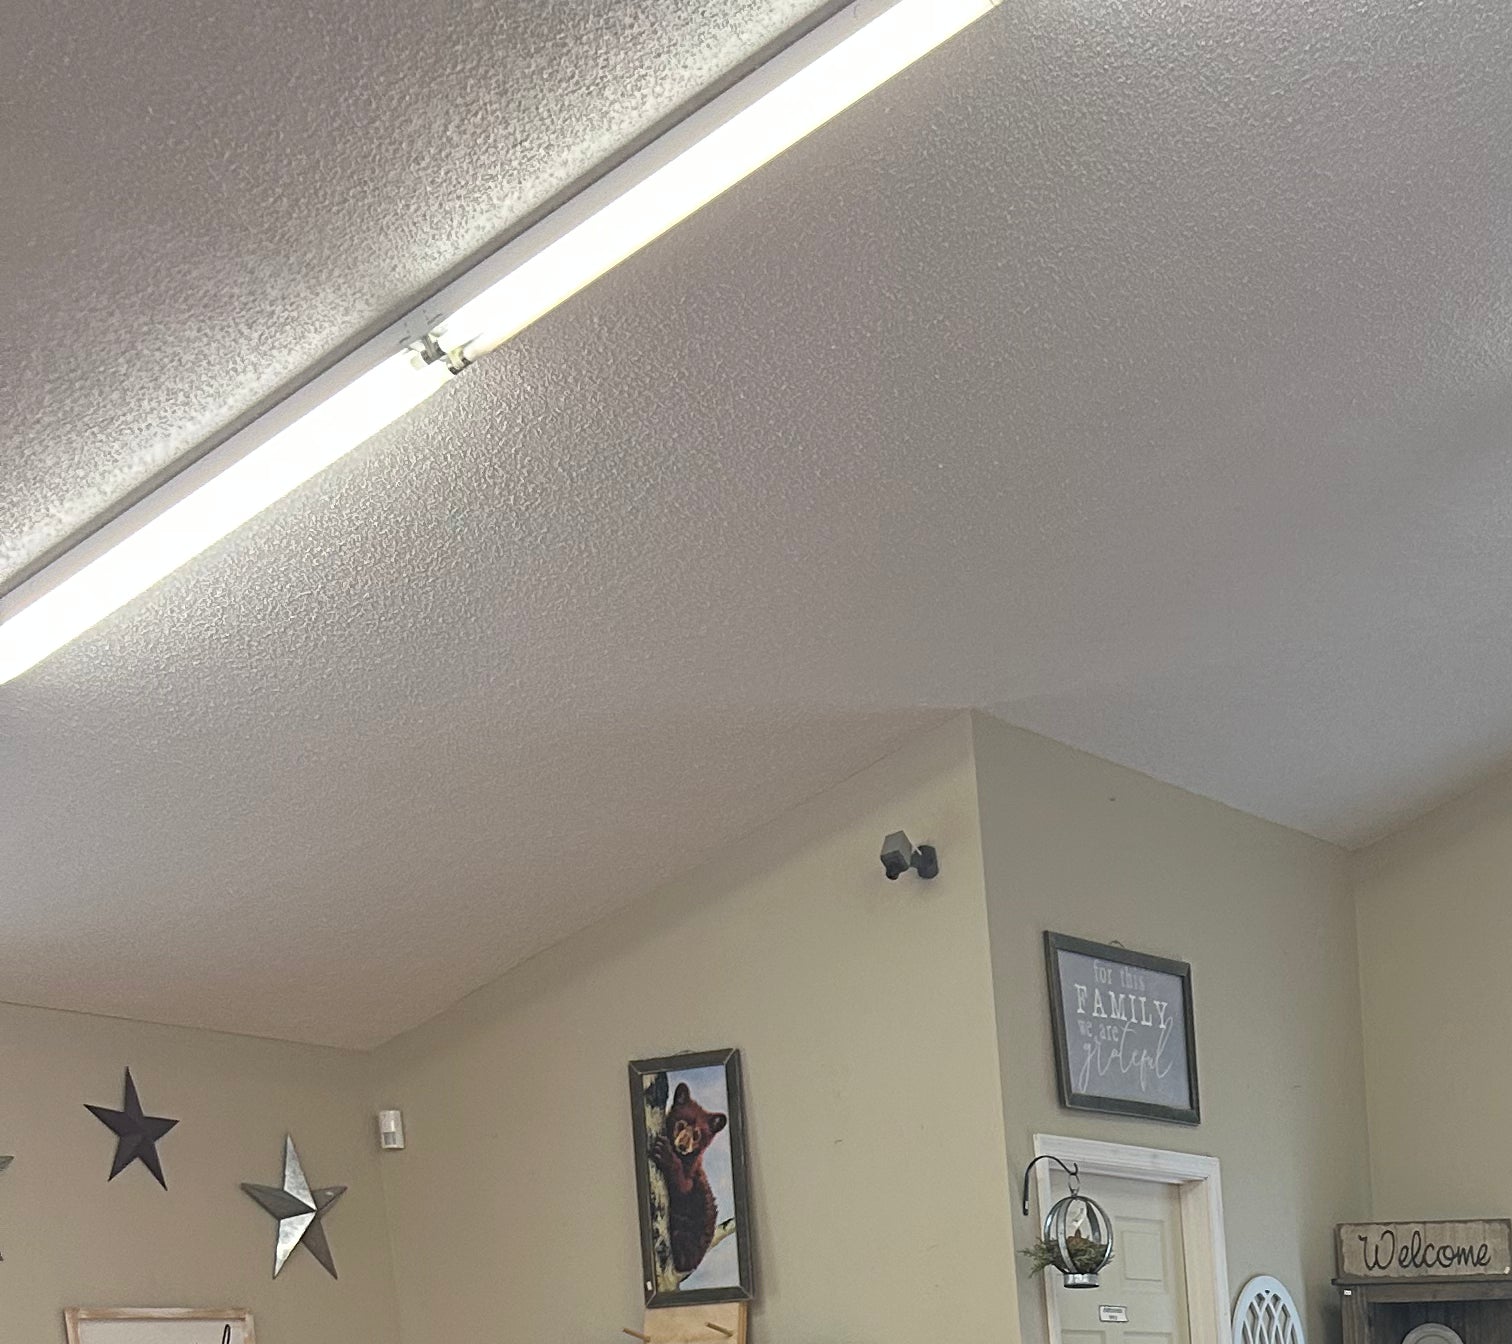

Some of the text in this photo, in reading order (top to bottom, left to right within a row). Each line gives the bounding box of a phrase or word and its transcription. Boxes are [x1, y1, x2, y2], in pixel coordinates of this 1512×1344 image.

[1093, 959, 1146, 991] for this
[1074, 983, 1168, 1029] FAMILY
[1077, 1020, 1119, 1042] we are
[1078, 1016, 1174, 1093] grateful
[1358, 1229, 1492, 1271] Welcome
